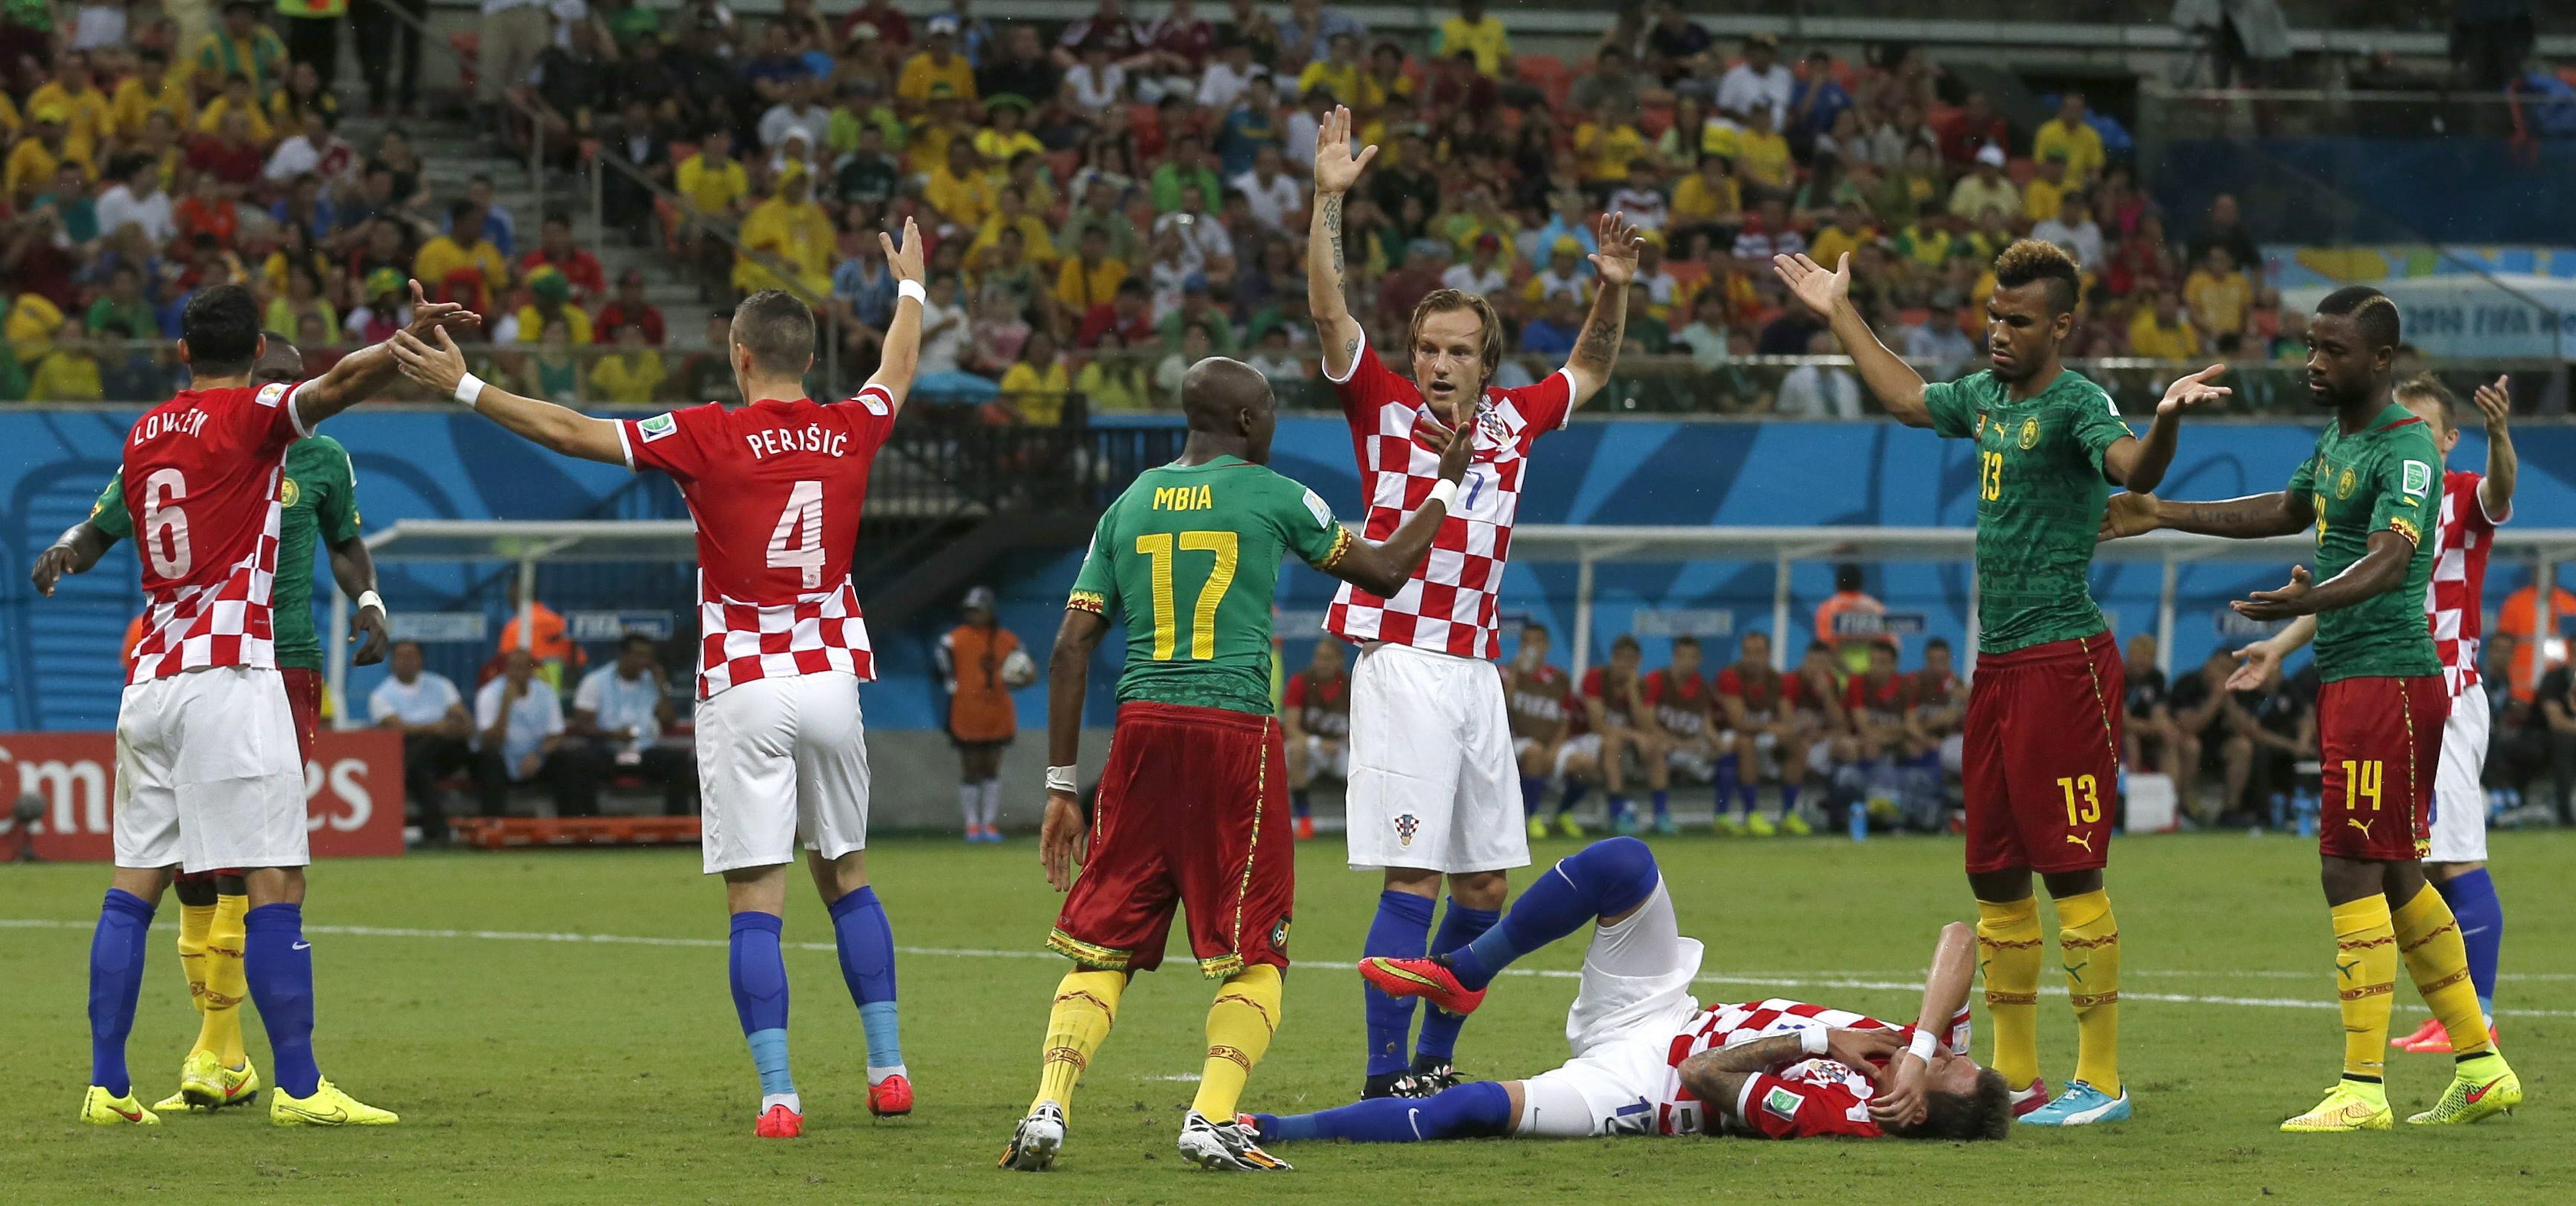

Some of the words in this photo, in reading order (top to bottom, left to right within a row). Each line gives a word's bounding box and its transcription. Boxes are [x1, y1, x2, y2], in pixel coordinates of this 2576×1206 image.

[746, 422, 847, 459] PERIŠIĆ
[1152, 484, 1212, 511] MBIA
[1982, 450, 2002, 501] 13
[144, 468, 191, 580] 6
[766, 481, 826, 589] 4
[1136, 531, 1238, 661] 17
[2056, 774, 2101, 826] 13
[2342, 760, 2382, 810] 14
